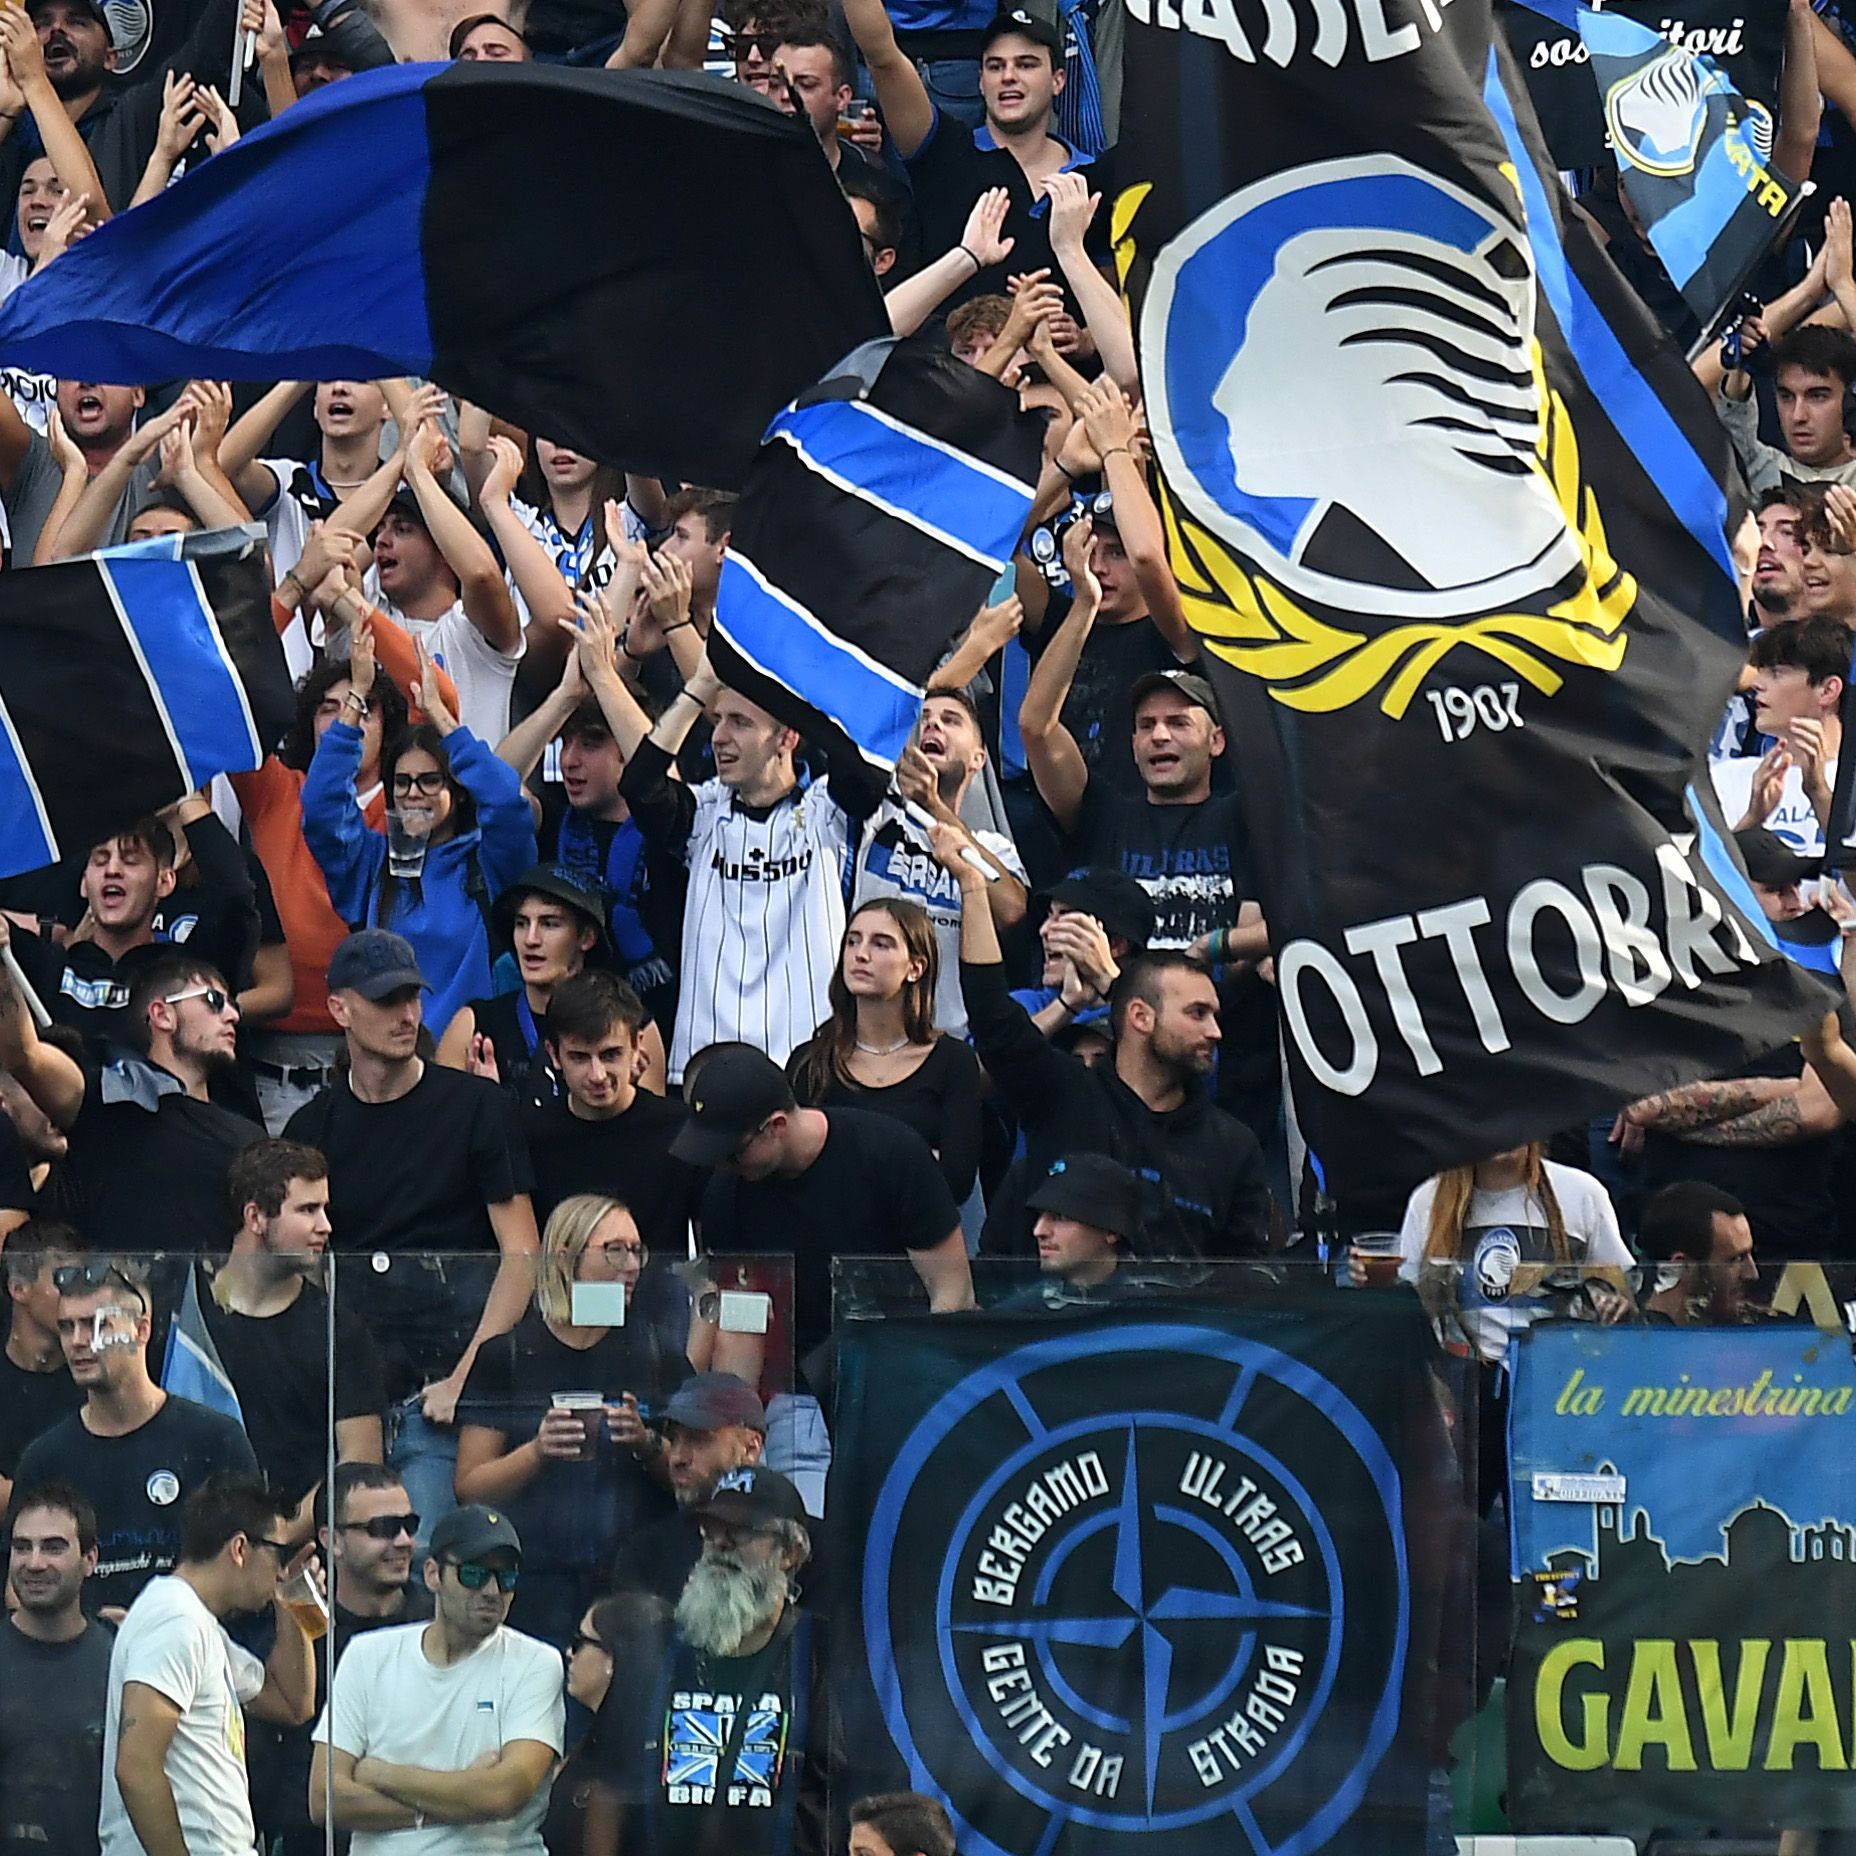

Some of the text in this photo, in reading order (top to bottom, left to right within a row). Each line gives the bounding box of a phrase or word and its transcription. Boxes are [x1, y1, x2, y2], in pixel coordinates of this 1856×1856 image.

[1424, 681, 1527, 742] 1907
[1278, 841, 1763, 1098] OTTOBR
[1620, 1369, 1853, 1419] minestrina
[971, 1450, 1306, 1607] BERGAMO ULTRAS
[982, 1641, 1306, 1800] GENTE DA STRADA
